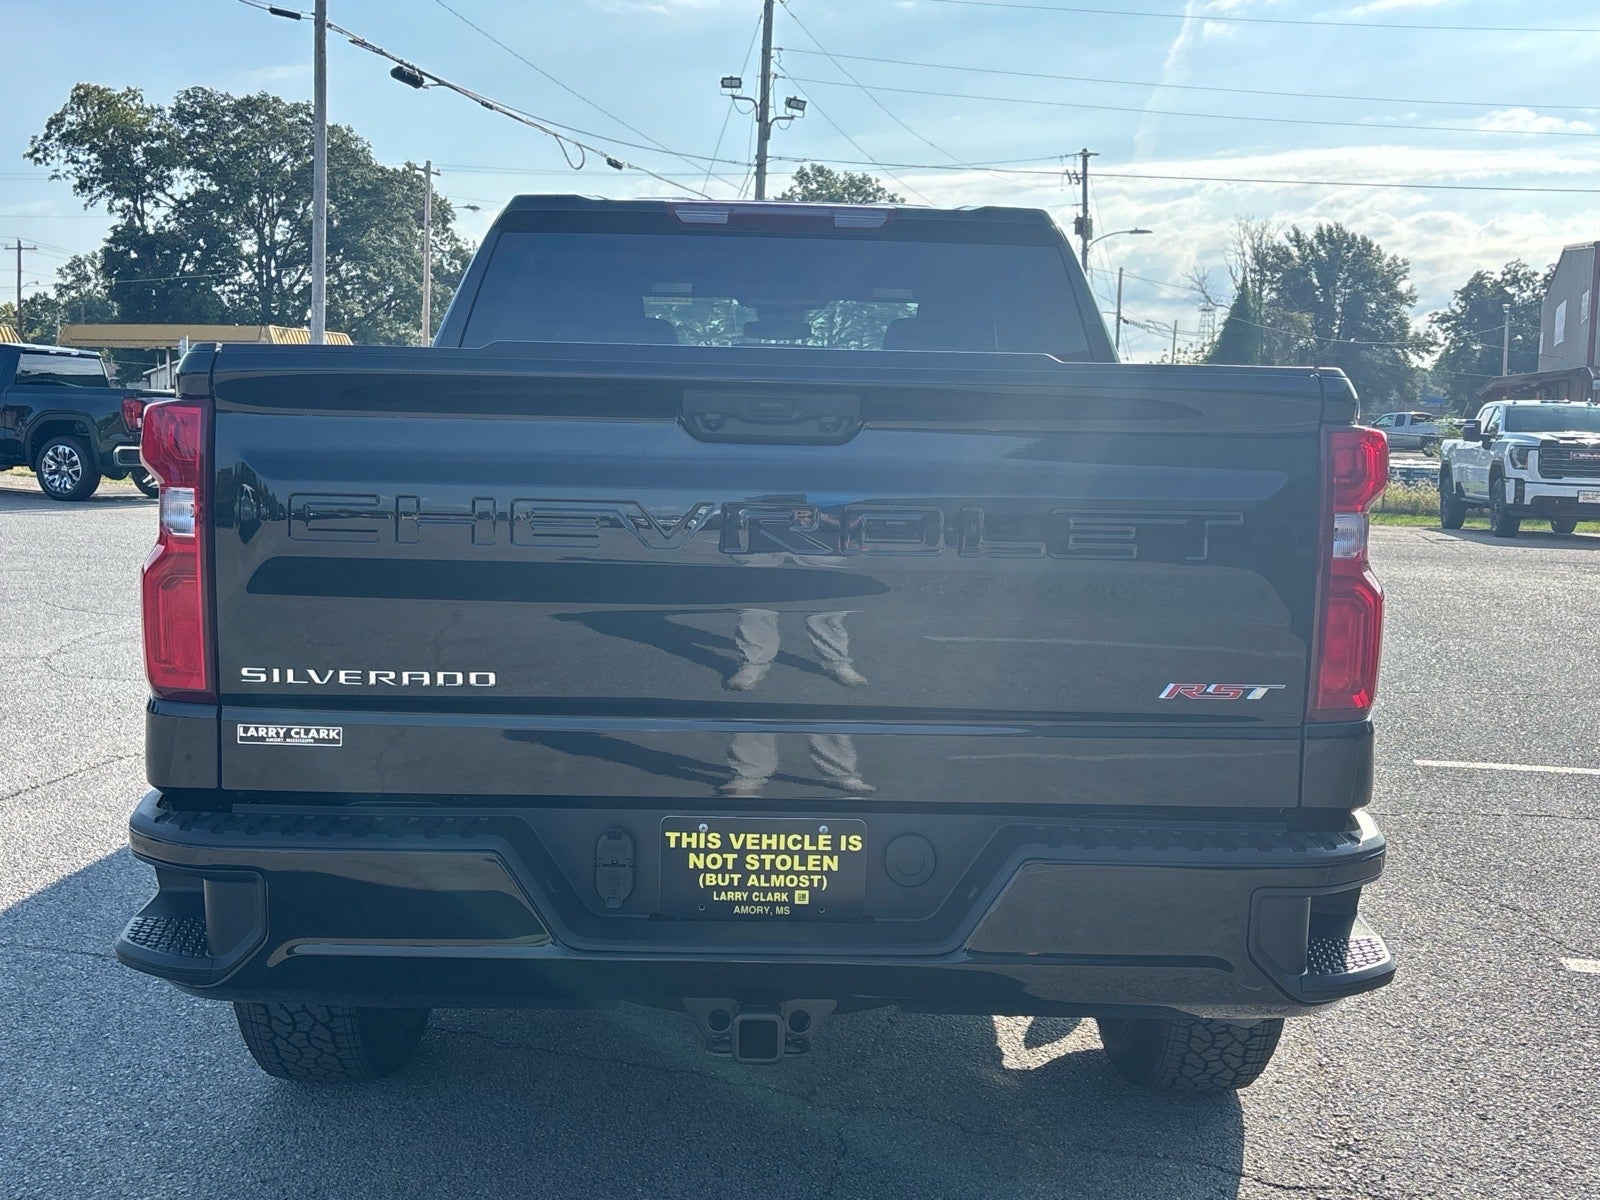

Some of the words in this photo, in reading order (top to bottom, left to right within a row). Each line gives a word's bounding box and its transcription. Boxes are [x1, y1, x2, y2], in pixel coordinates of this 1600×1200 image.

[288, 493, 1244, 561] CHEVROLET
[240, 667, 496, 686] SILVERADO
[1158, 683, 1286, 700] RST
[239, 726, 287, 738] LARRY
[290, 728, 340, 739] CLARK
[665, 831, 722, 849] THIS
[729, 833, 832, 851] VEHICLE
[840, 835, 863, 851] IS
[688, 853, 738, 870] NOT
[745, 854, 839, 871] STOLEN
[698, 873, 742, 889] (BUT
[747, 874, 828, 891] ALMOST)
[713, 891, 748, 902] LARRY
[752, 891, 789, 903] CLARK
[733, 905, 773, 916] AMORY,
[775, 906, 791, 916] MS
